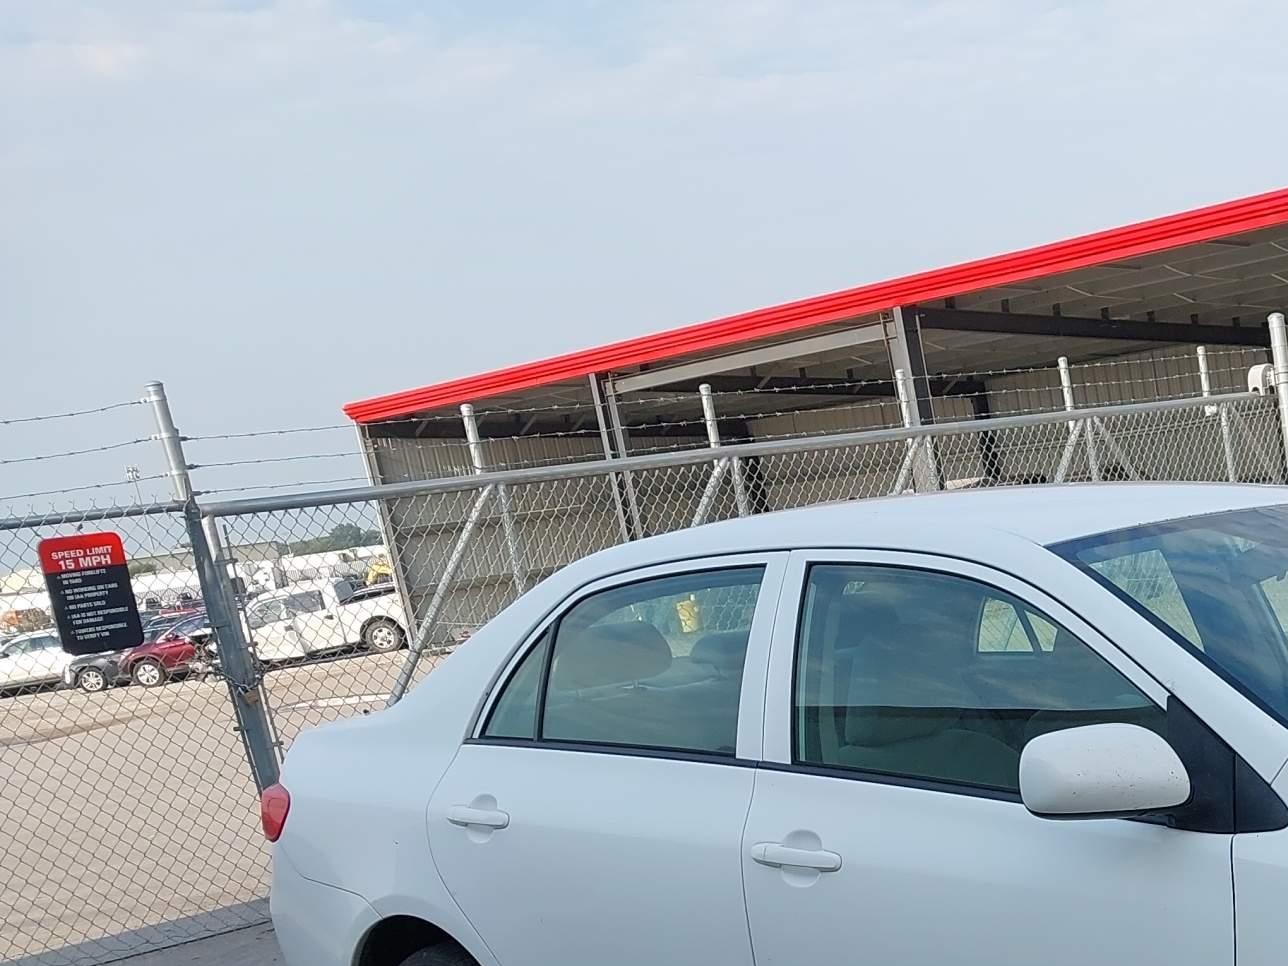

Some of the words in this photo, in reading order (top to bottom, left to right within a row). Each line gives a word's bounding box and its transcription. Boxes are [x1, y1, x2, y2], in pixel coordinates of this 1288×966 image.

[51, 549, 84, 560] SPEED
[86, 545, 113, 556] LIMIT
[58, 559, 75, 570] 15
[78, 554, 112, 568] MPH
[60, 571, 82, 579] MOVING
[73, 585, 97, 593] WORKING
[84, 590, 109, 599] PROPERTY
[77, 601, 94, 609] PARTS
